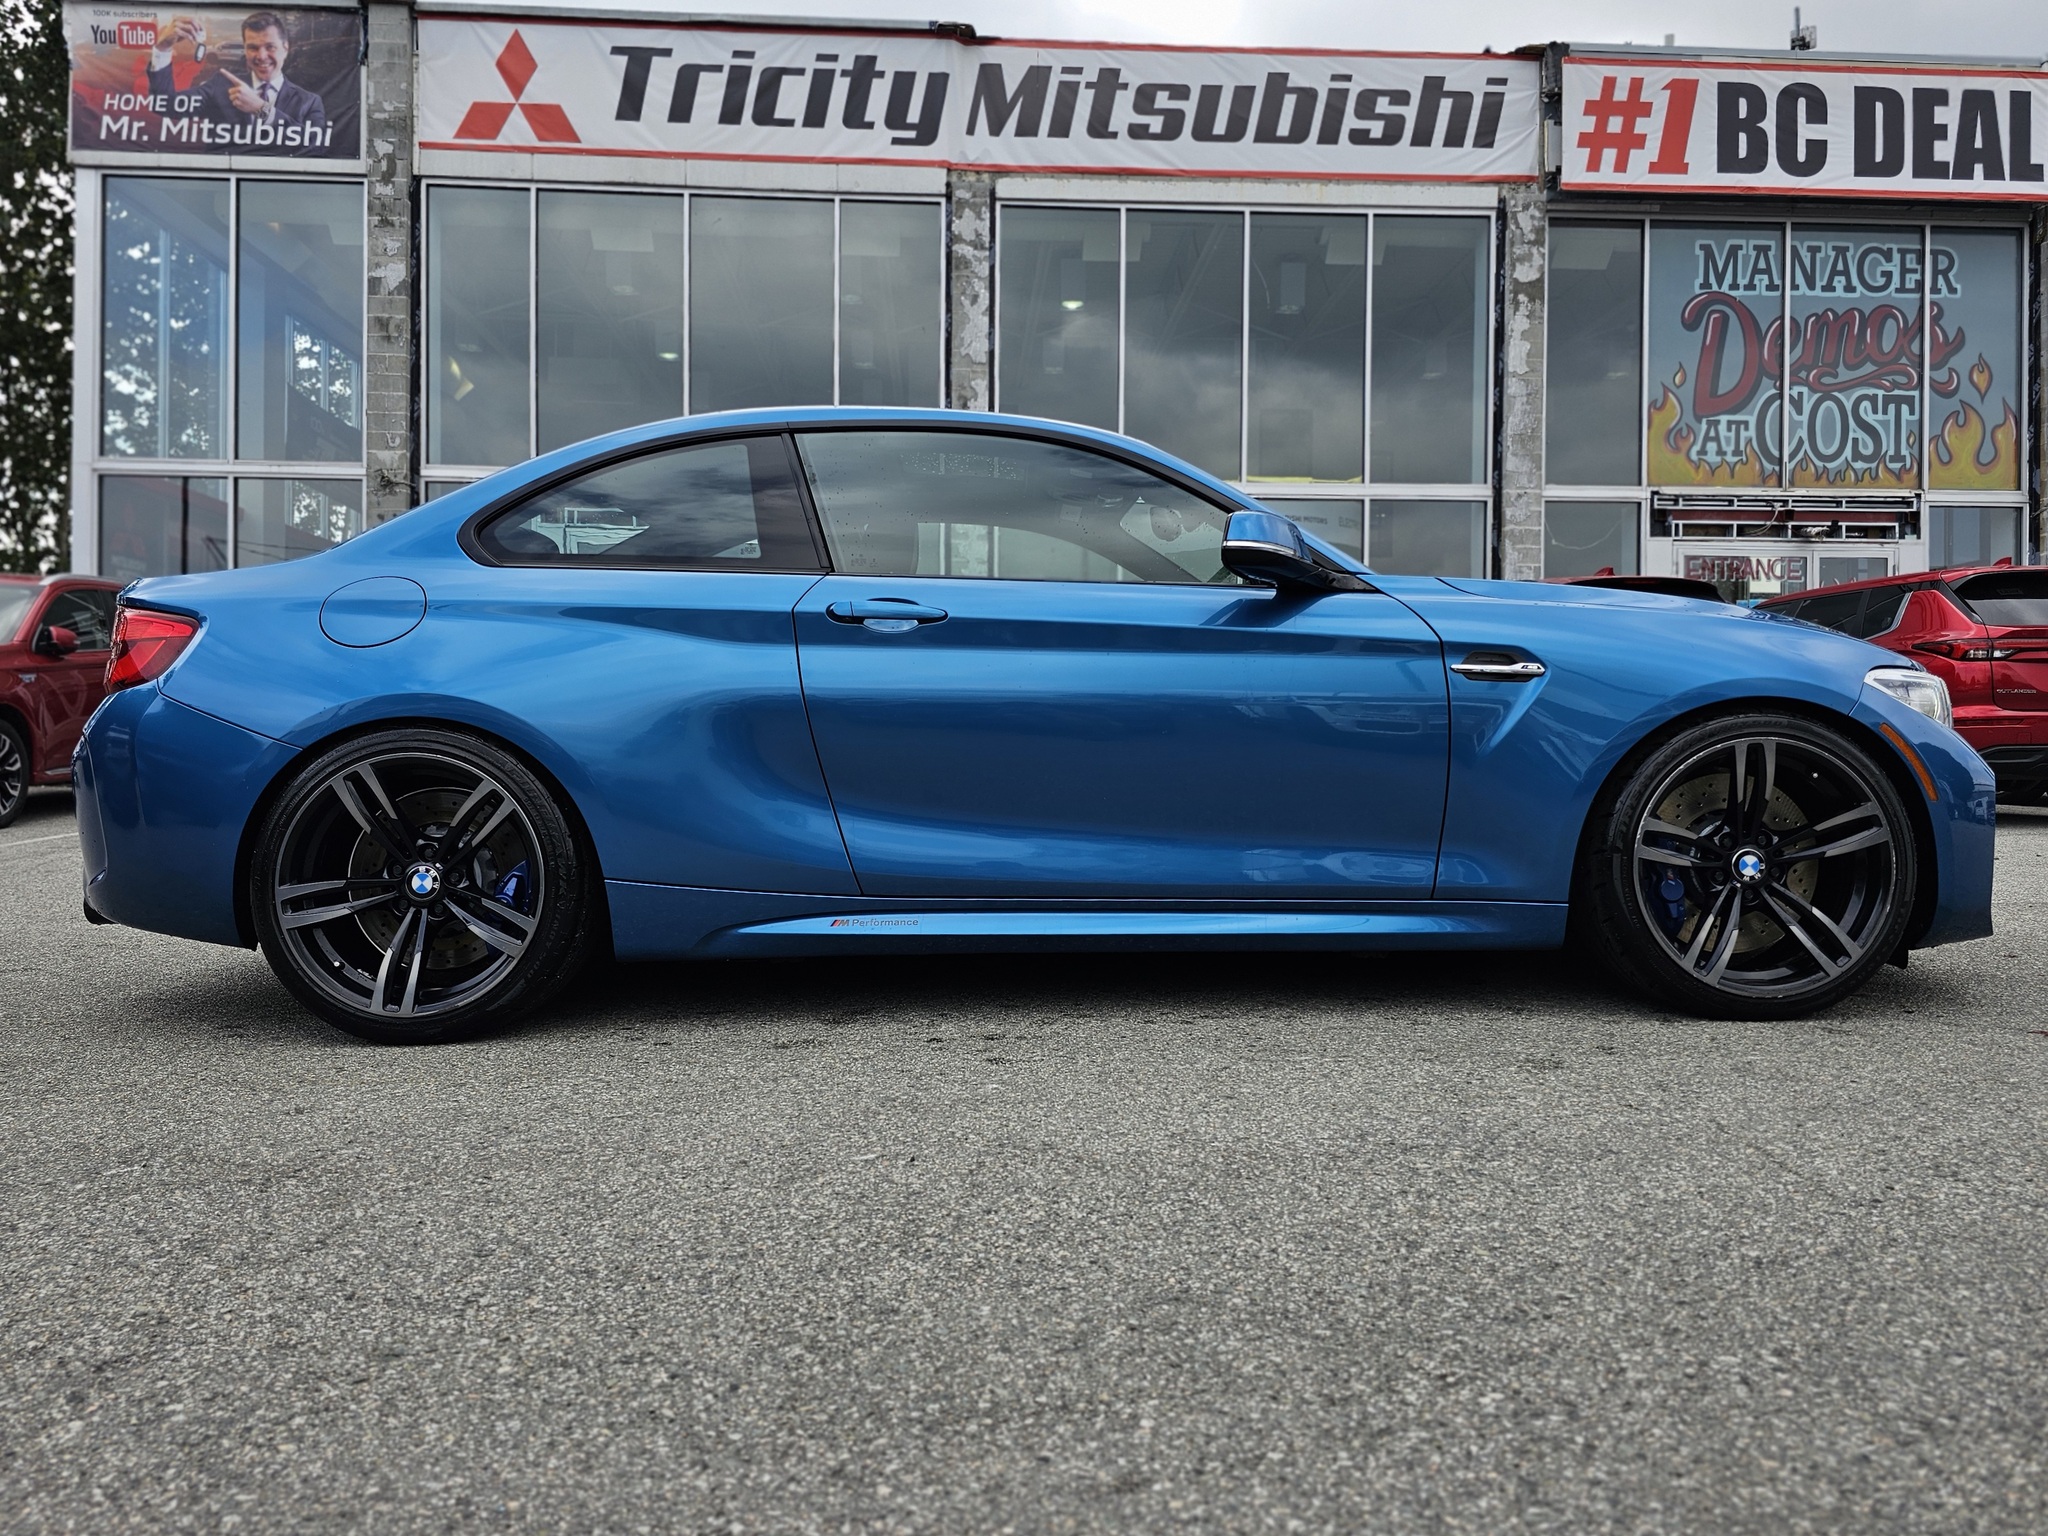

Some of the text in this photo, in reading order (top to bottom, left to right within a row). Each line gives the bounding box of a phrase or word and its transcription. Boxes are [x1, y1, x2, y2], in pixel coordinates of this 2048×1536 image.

[92, 9, 158, 18] 100K subscribers
[103, 93, 202, 113] HOME OF
[609, 45, 1509, 149] Tricity Mitsubishi
[99, 114, 333, 147] Mr. Mitsubishi
[1576, 75, 2045, 182] #1 BC DEAL
[1697, 241, 1960, 296] MANAGER
[1681, 290, 1965, 418] Demos
[1695, 390, 1918, 467] AT COST
[1685, 556, 1805, 583] ENTRANCE
[851, 918, 919, 928] Performance
